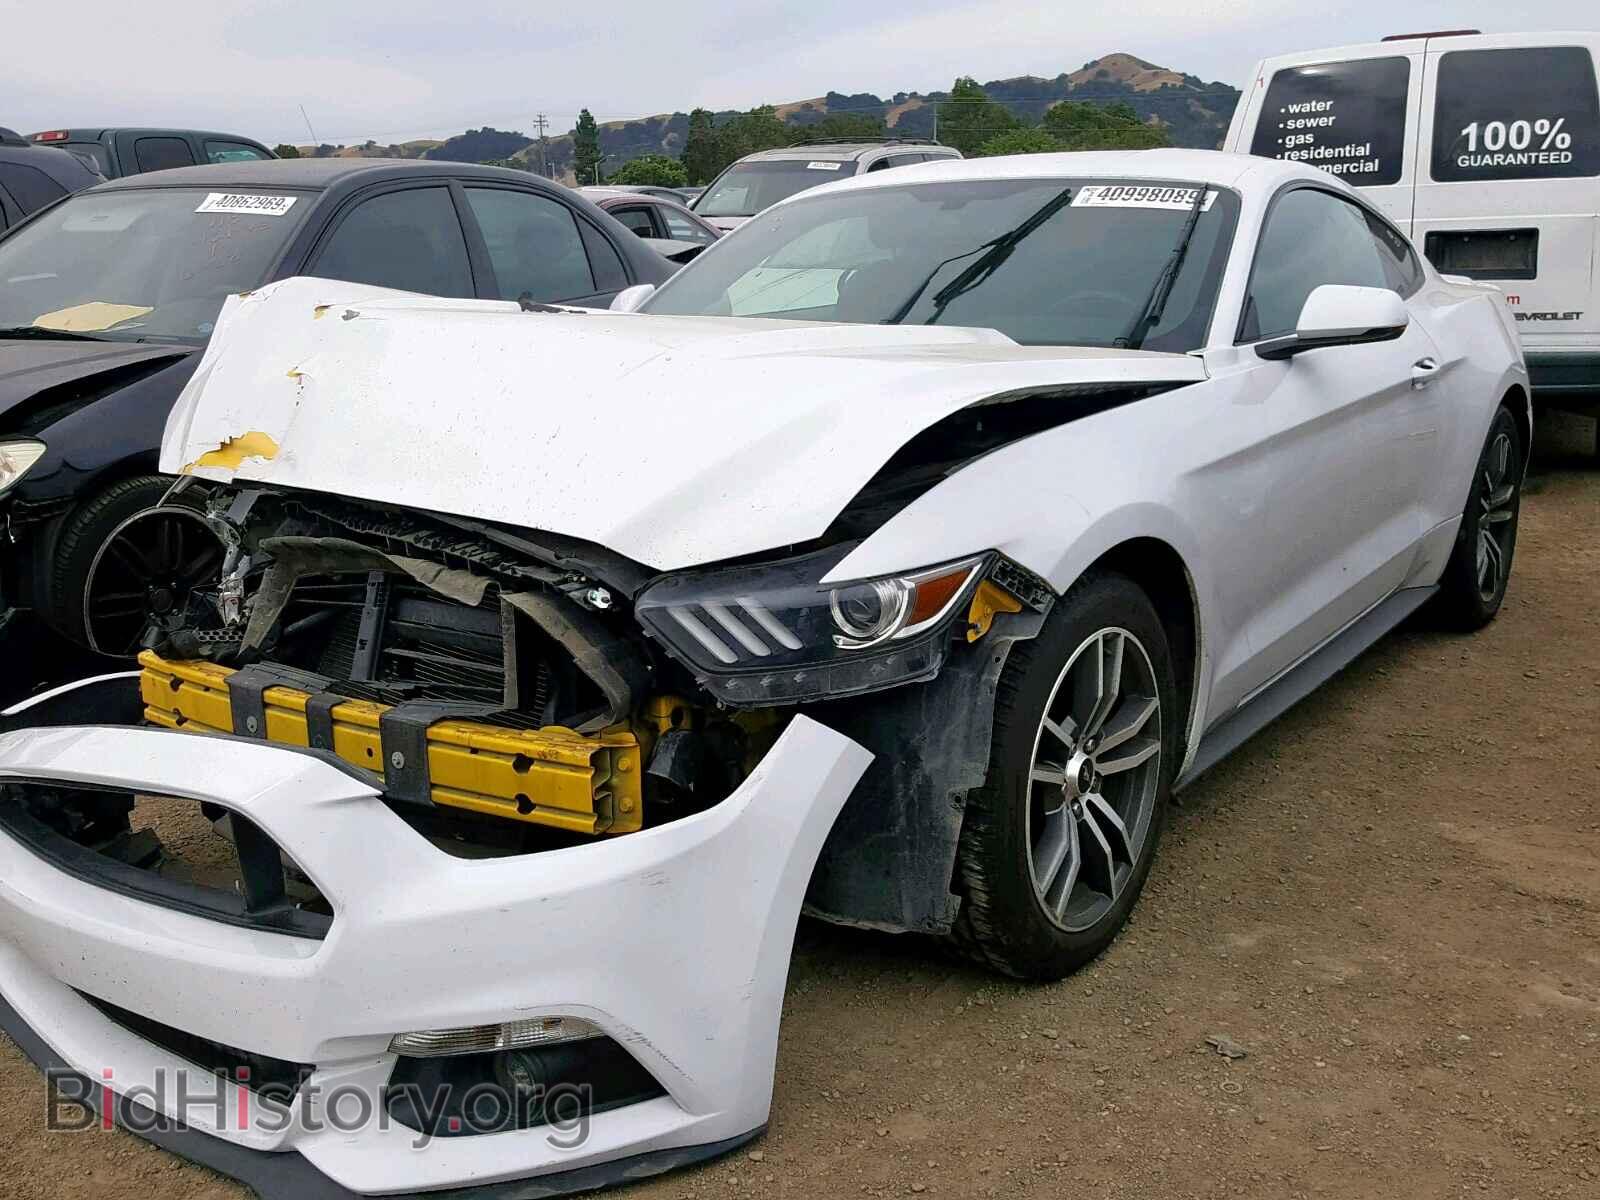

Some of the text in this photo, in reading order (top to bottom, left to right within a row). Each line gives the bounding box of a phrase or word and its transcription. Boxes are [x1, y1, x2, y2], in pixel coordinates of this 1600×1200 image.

[1287, 100, 1334, 114] water
[1286, 116, 1336, 129] sewer
[1285, 133, 1314, 148] gas
[1461, 118, 1571, 152] 100%
[1284, 142, 1370, 160] residential
[1318, 158, 1379, 174] mercial
[1457, 151, 1572, 167] GUARANTEED
[1513, 312, 1584, 321] EVROLET
